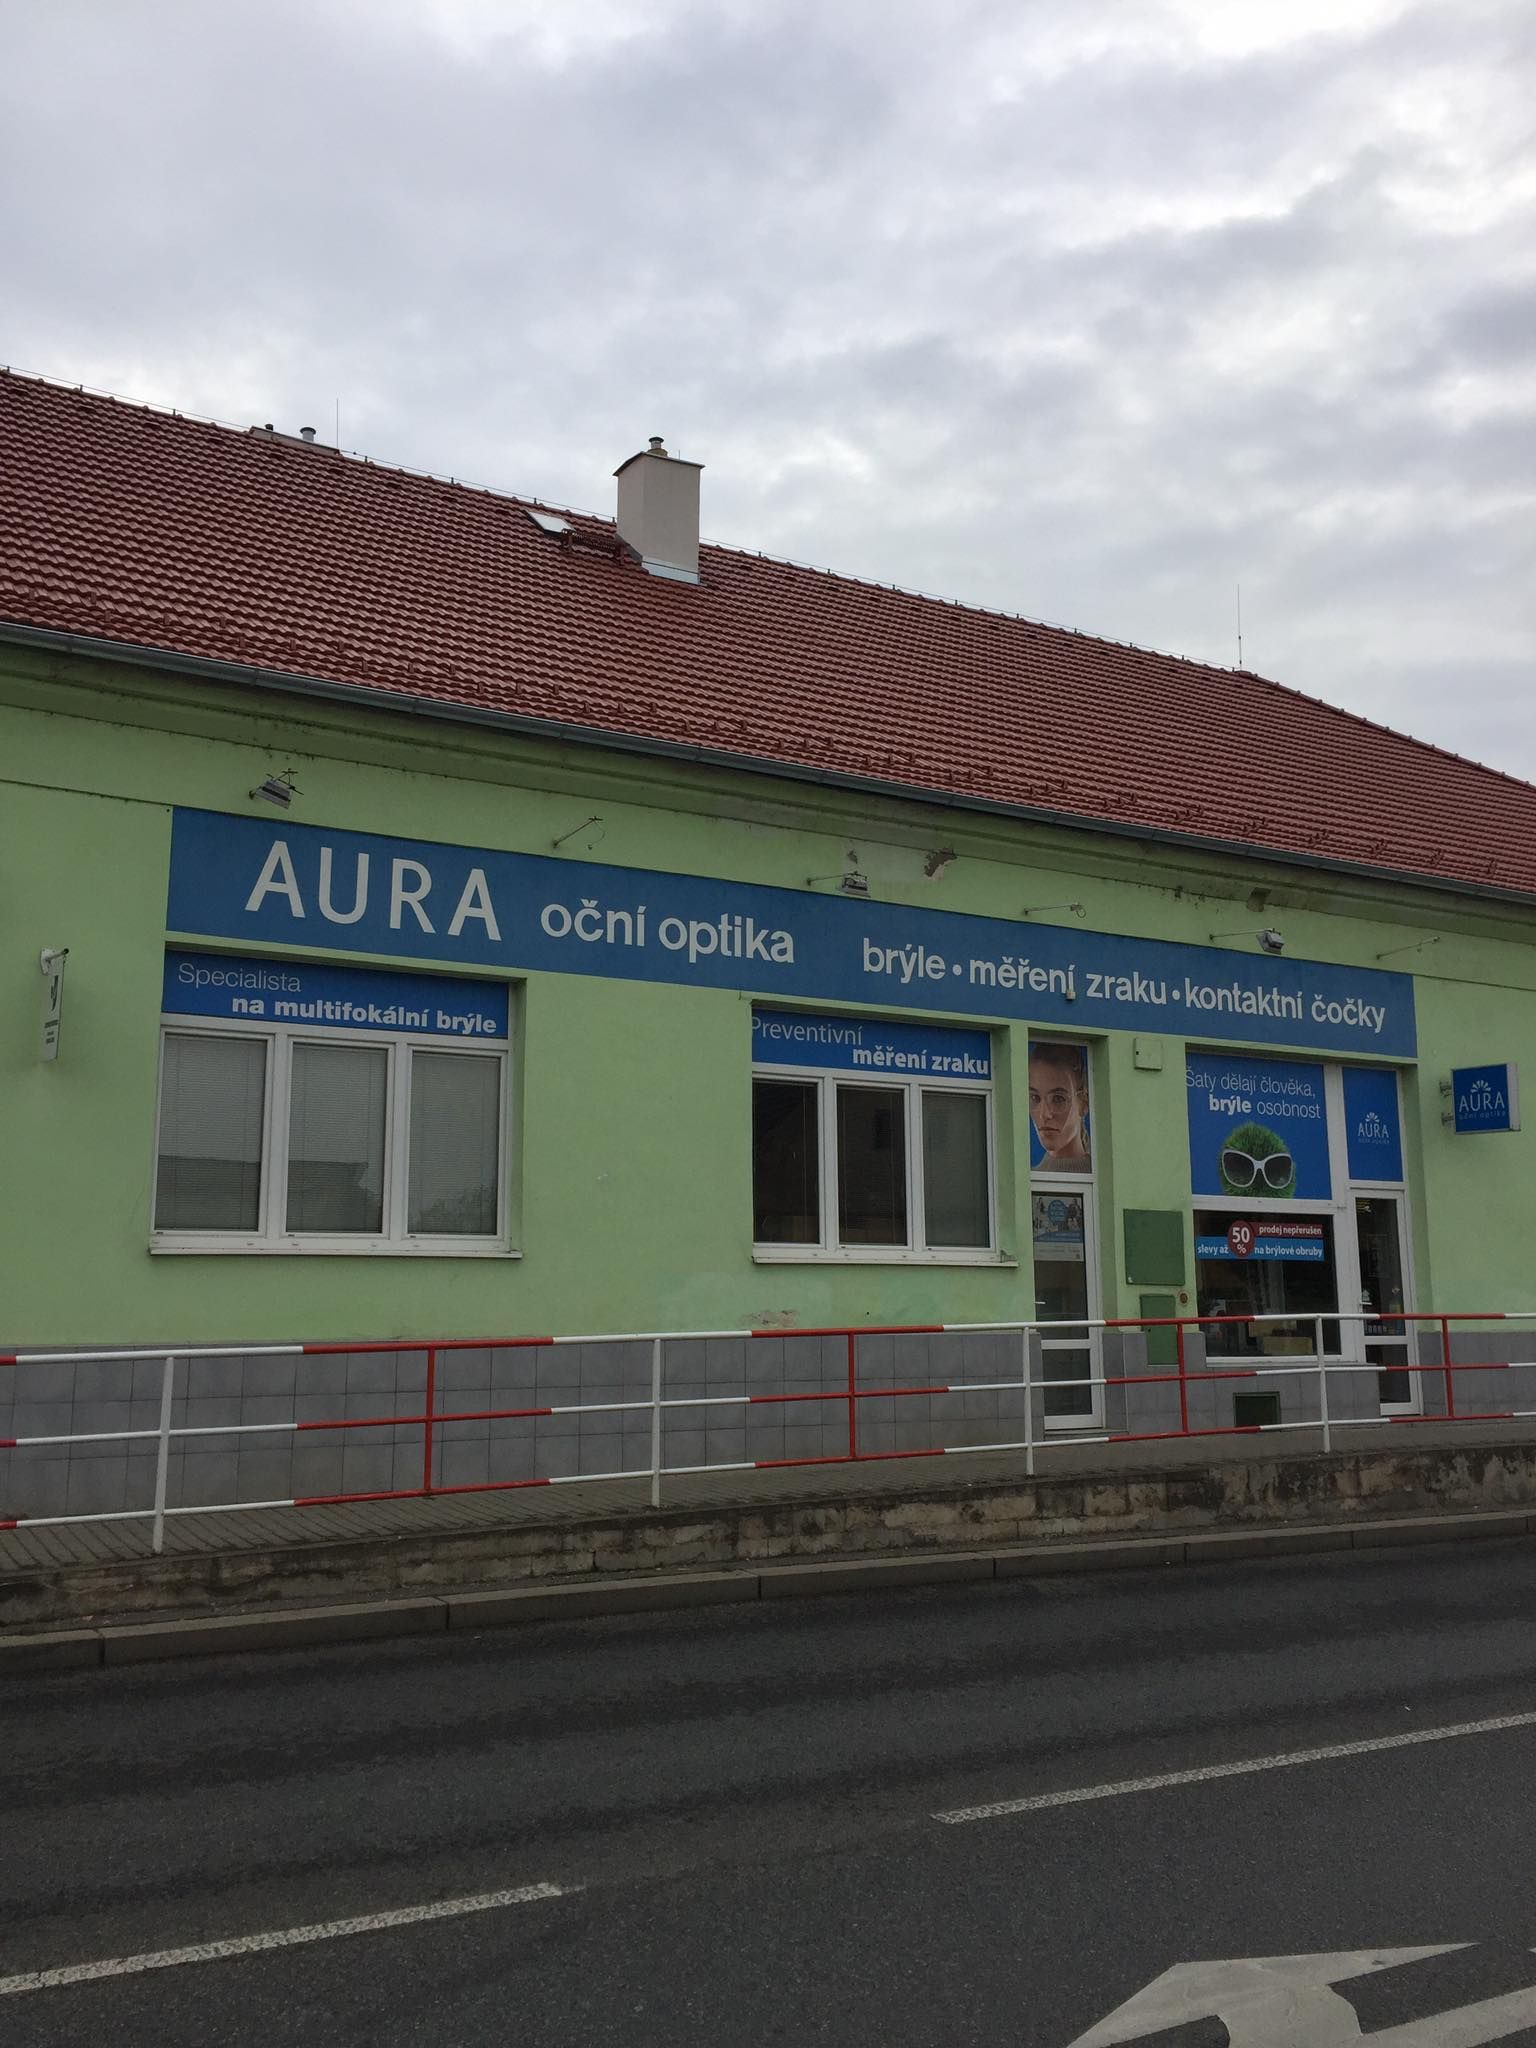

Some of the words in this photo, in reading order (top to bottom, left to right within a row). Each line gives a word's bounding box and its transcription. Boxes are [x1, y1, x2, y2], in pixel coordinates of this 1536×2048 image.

[245, 840, 502, 941] AURA
[540, 898, 645, 947] oční
[658, 913, 795, 963] optika
[863, 937, 946, 984] brýle
[969, 955, 1075, 994] měření
[1086, 970, 1167, 1005] zraku
[1184, 977, 1303, 1020] kontaktní
[1311, 993, 1386, 1034] čočky
[178, 962, 302, 993] Specialista
[232, 995, 265, 1015] na
[274, 998, 430, 1028] multifokální
[436, 1009, 498, 1036] brýle
[852, 1044, 927, 1070] měření
[931, 1053, 990, 1076] zraku
[1186, 1067, 1216, 1091] Šaty
[1220, 1073, 1257, 1096] dělají
[1209, 1095, 1252, 1115] brýle
[1256, 1100, 1321, 1119] osobnost
[1459, 1092, 1505, 1112] AURA
[1358, 1122, 1390, 1139] AURA
[1231, 1226, 1251, 1244] 50
[1258, 1223, 1283, 1236] prodej
[1283, 1224, 1322, 1237] nepřerušen
[1197, 1242, 1219, 1256] slevy
[1219, 1243, 1229, 1255] až
[1236, 1243, 1247, 1254] %
[1254, 1246, 1265, 1255] na
[1265, 1244, 1294, 1257] brýlové
[1295, 1246, 1323, 1258] obruby
